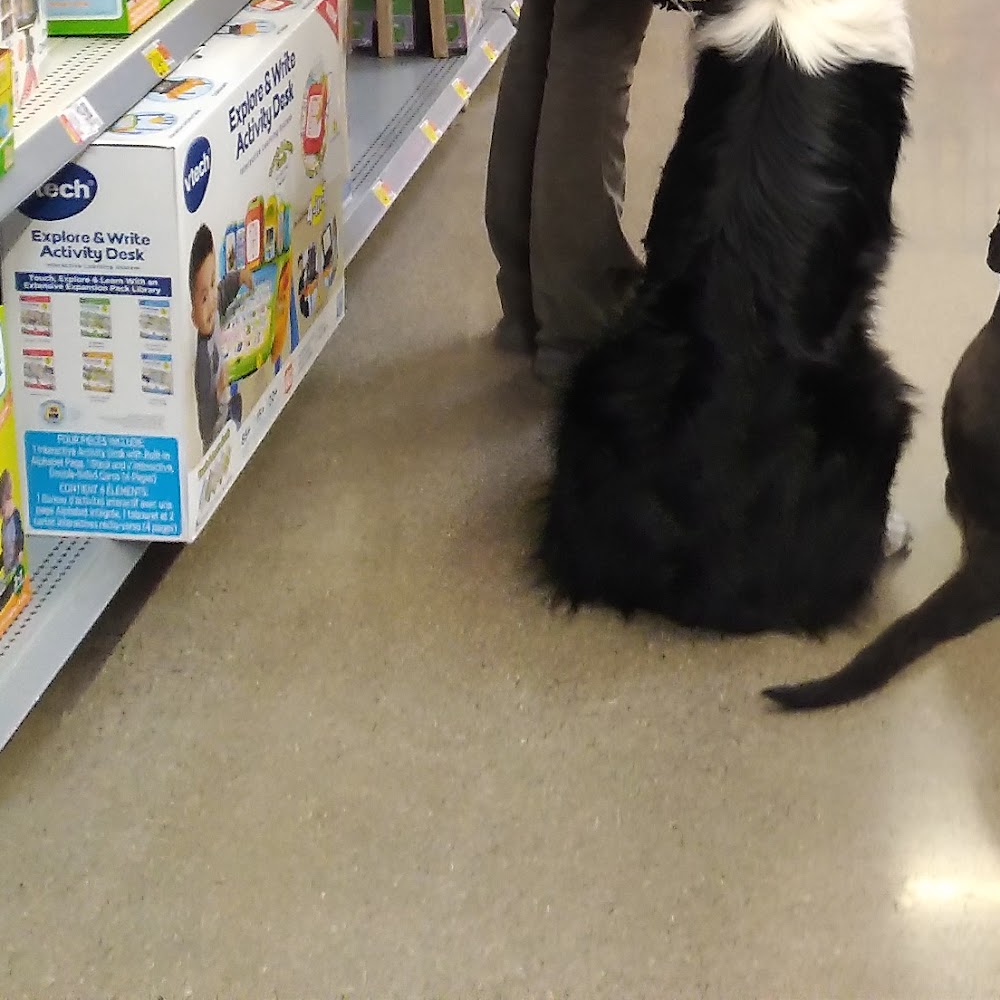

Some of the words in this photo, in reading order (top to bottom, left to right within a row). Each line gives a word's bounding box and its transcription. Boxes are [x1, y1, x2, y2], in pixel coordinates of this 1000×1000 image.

[229, 85, 263, 132] Explore
[271, 50, 296, 88] Write
[236, 109, 272, 160] Activity
[272, 80, 295, 118] Desk
[31, 230, 90, 245] Explore
[93, 231, 105, 244] &
[108, 233, 150, 246] Write
[40, 246, 102, 263] Activity
[106, 248, 145, 261] Desk
